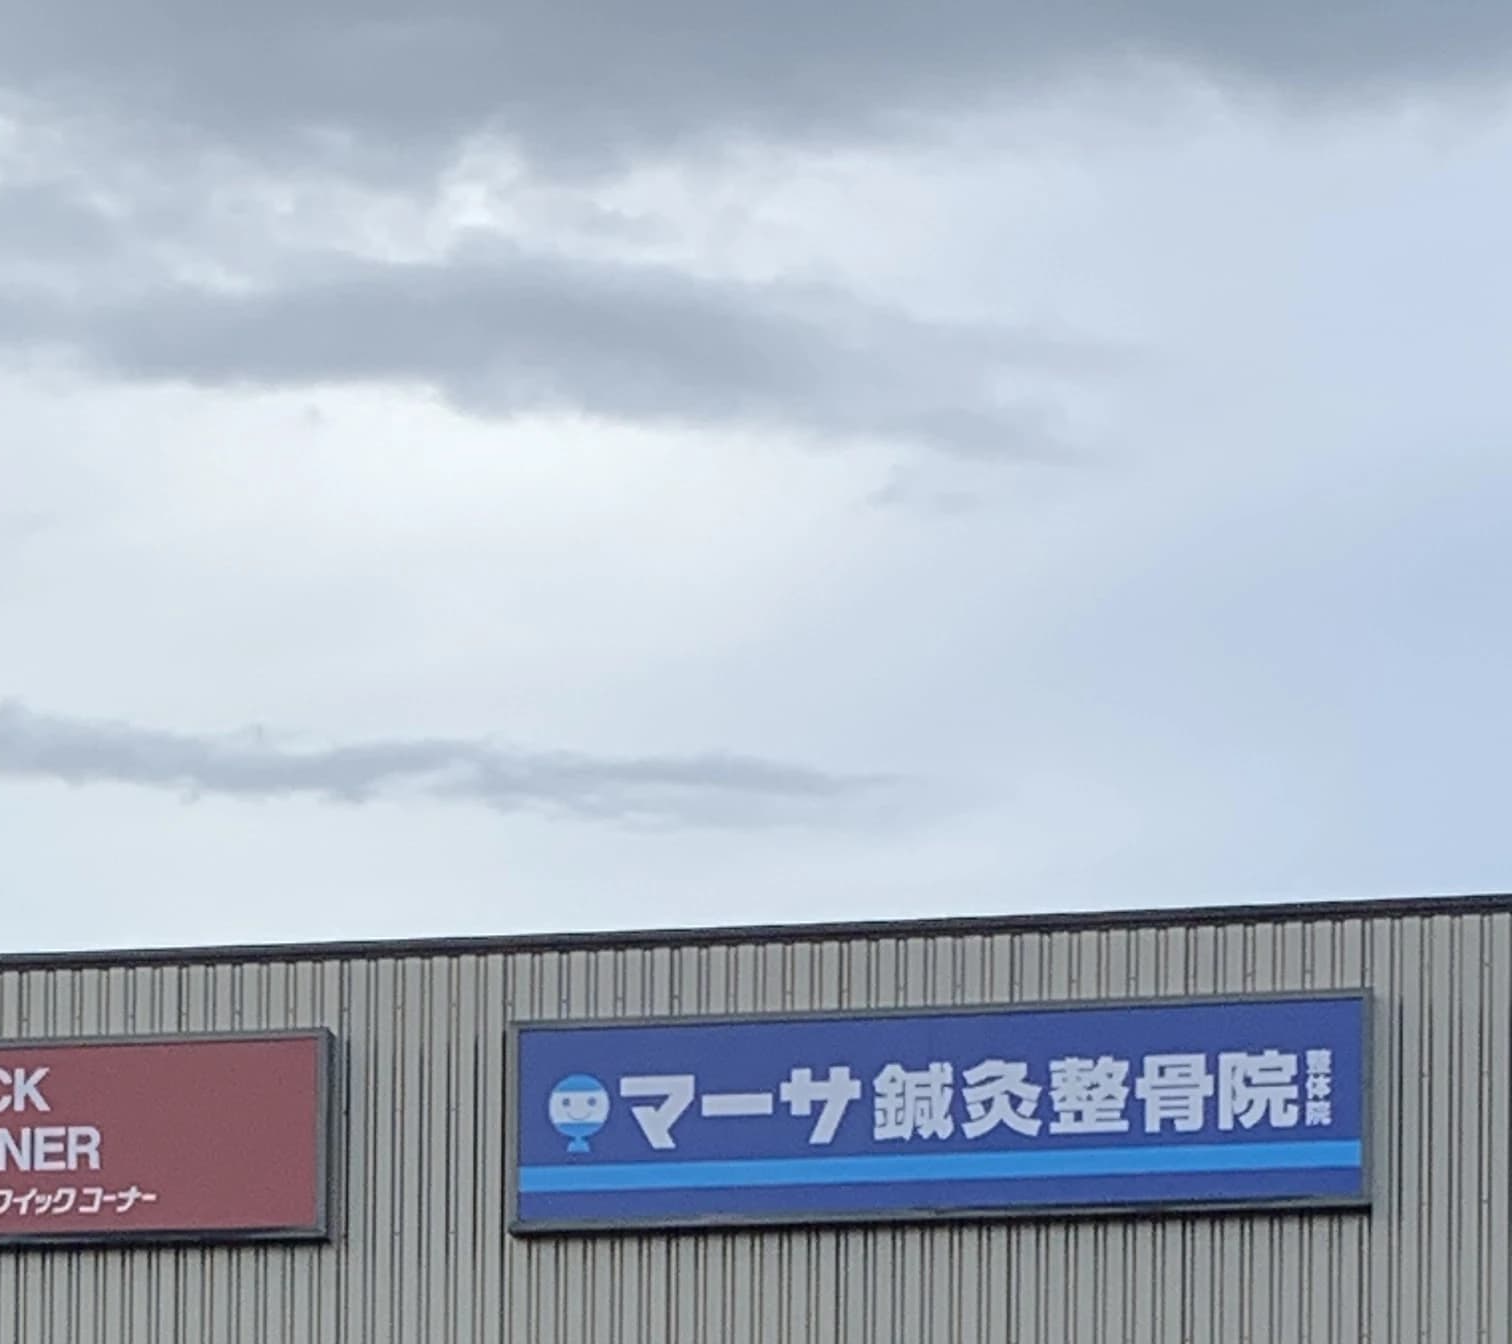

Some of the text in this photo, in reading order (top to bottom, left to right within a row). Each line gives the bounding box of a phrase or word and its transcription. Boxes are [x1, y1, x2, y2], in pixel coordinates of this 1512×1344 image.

[619, 1050, 1299, 1150] マーサ鍼灸整骨院
